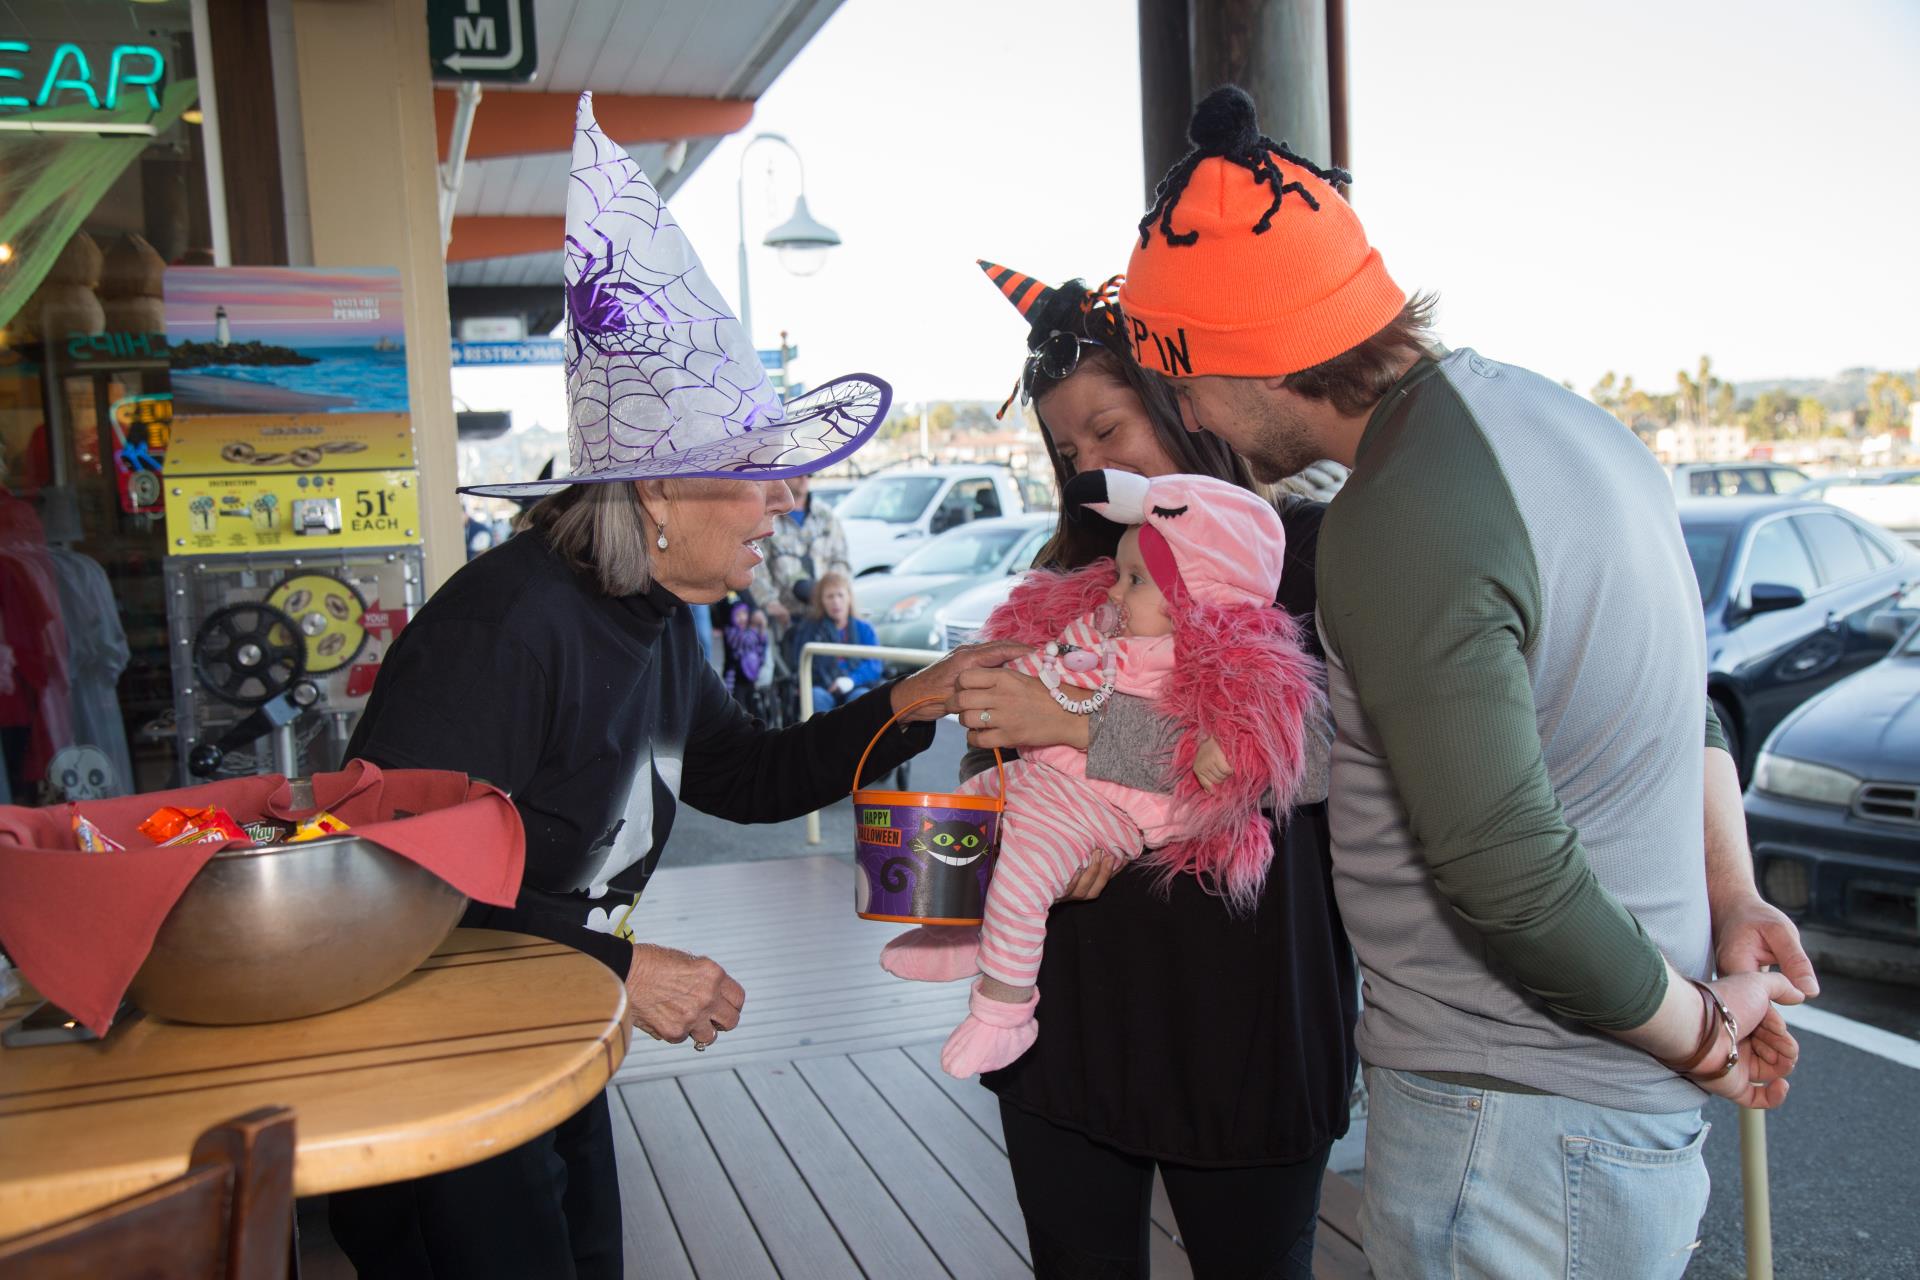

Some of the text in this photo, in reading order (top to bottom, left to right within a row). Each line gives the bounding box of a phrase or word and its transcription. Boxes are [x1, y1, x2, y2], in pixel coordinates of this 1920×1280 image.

[333, 309, 381, 320] PENNIES
[1124, 314, 1193, 376] PIN
[463, 344, 563, 361] RESTROOMS
[352, 518, 399, 531] EACH
[365, 613, 389, 625] YOUR
[864, 811, 888, 825] HAPPY
